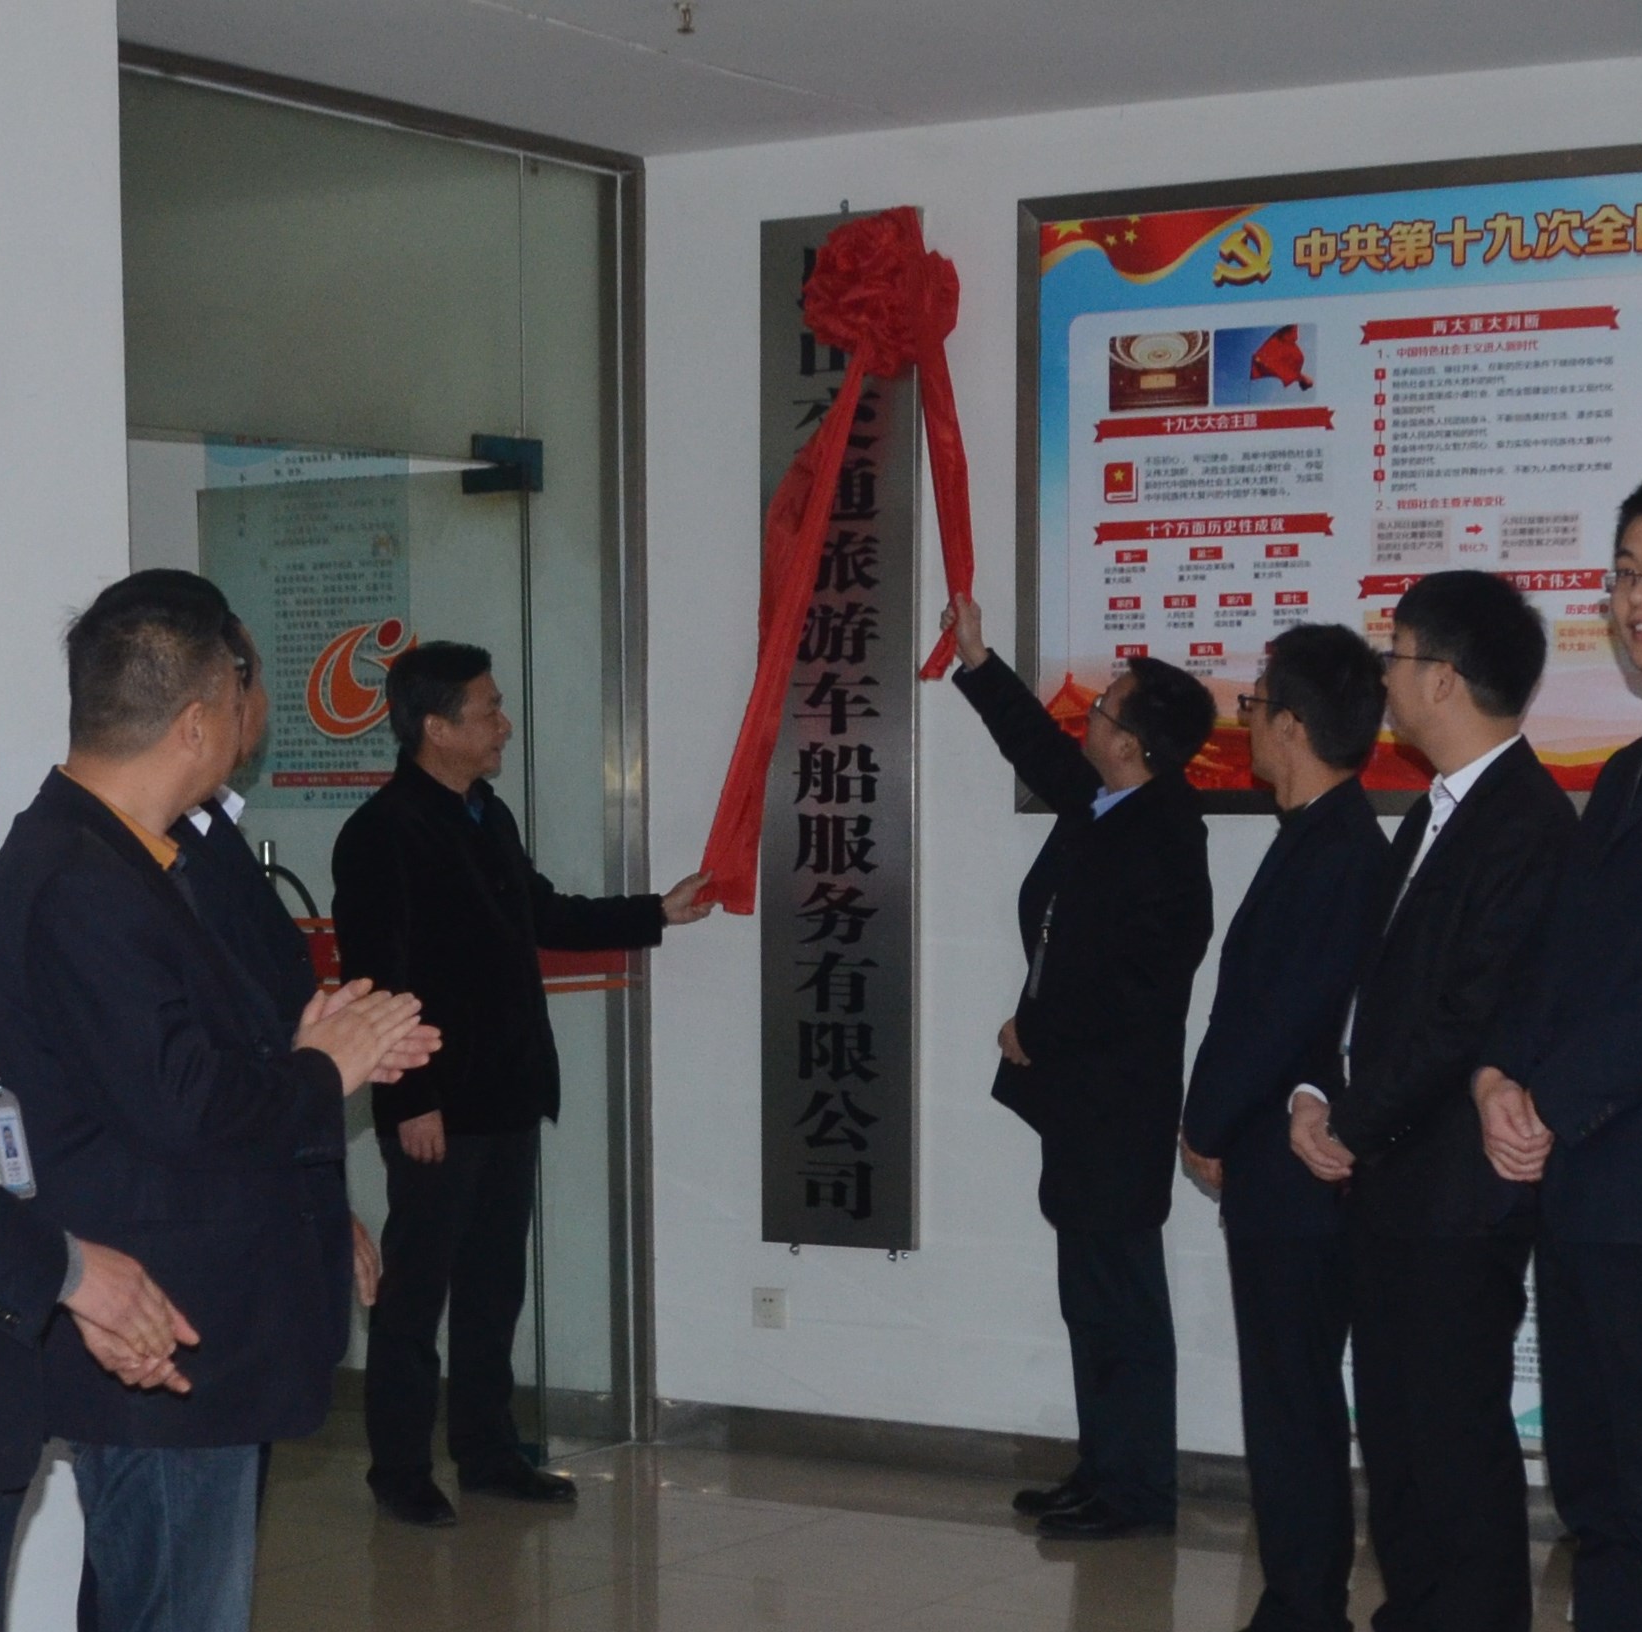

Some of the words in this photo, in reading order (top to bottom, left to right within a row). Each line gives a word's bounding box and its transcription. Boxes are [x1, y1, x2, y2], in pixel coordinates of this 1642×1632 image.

[1432, 314, 1540, 335] 两大重大判断
[1162, 413, 1257, 432] 十九大大会主题
[1146, 517, 1285, 537] 十个方面历史性成就
